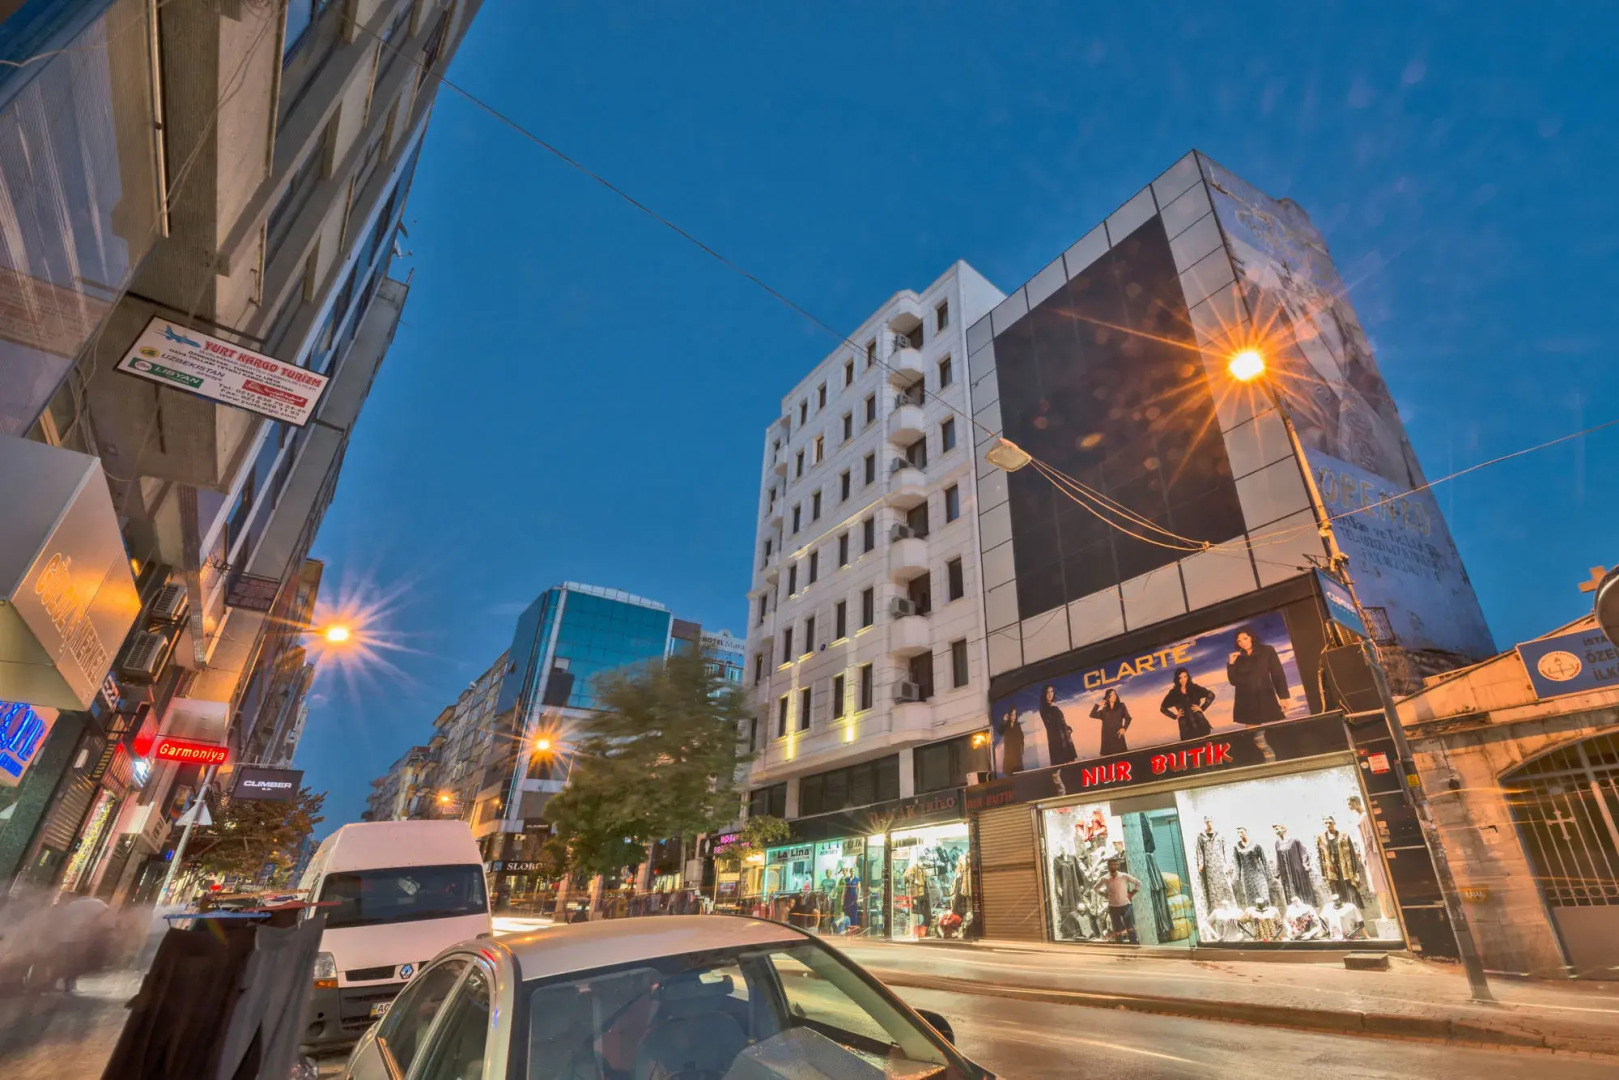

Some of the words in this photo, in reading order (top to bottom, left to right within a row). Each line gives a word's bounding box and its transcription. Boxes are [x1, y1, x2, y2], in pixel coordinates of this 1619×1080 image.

[160, 353, 226, 377] UZBEKISTAN
[202, 340, 232, 369] YURT
[236, 352, 279, 373] KARGO
[278, 365, 322, 388] TURİZM
[153, 365, 200, 384] LIBYAN
[235, 388, 255, 397] 0212
[240, 395, 258, 403] 0212
[217, 393, 297, 420] www.yurtkargo.com
[159, 743, 225, 762] Garmoniya
[1082, 761, 1132, 788] NUR
[1151, 741, 1232, 777] BUTİK
[243, 780, 293, 789] CLIMBER
[777, 850, 787, 859] La
[791, 848, 809, 857] Lina
